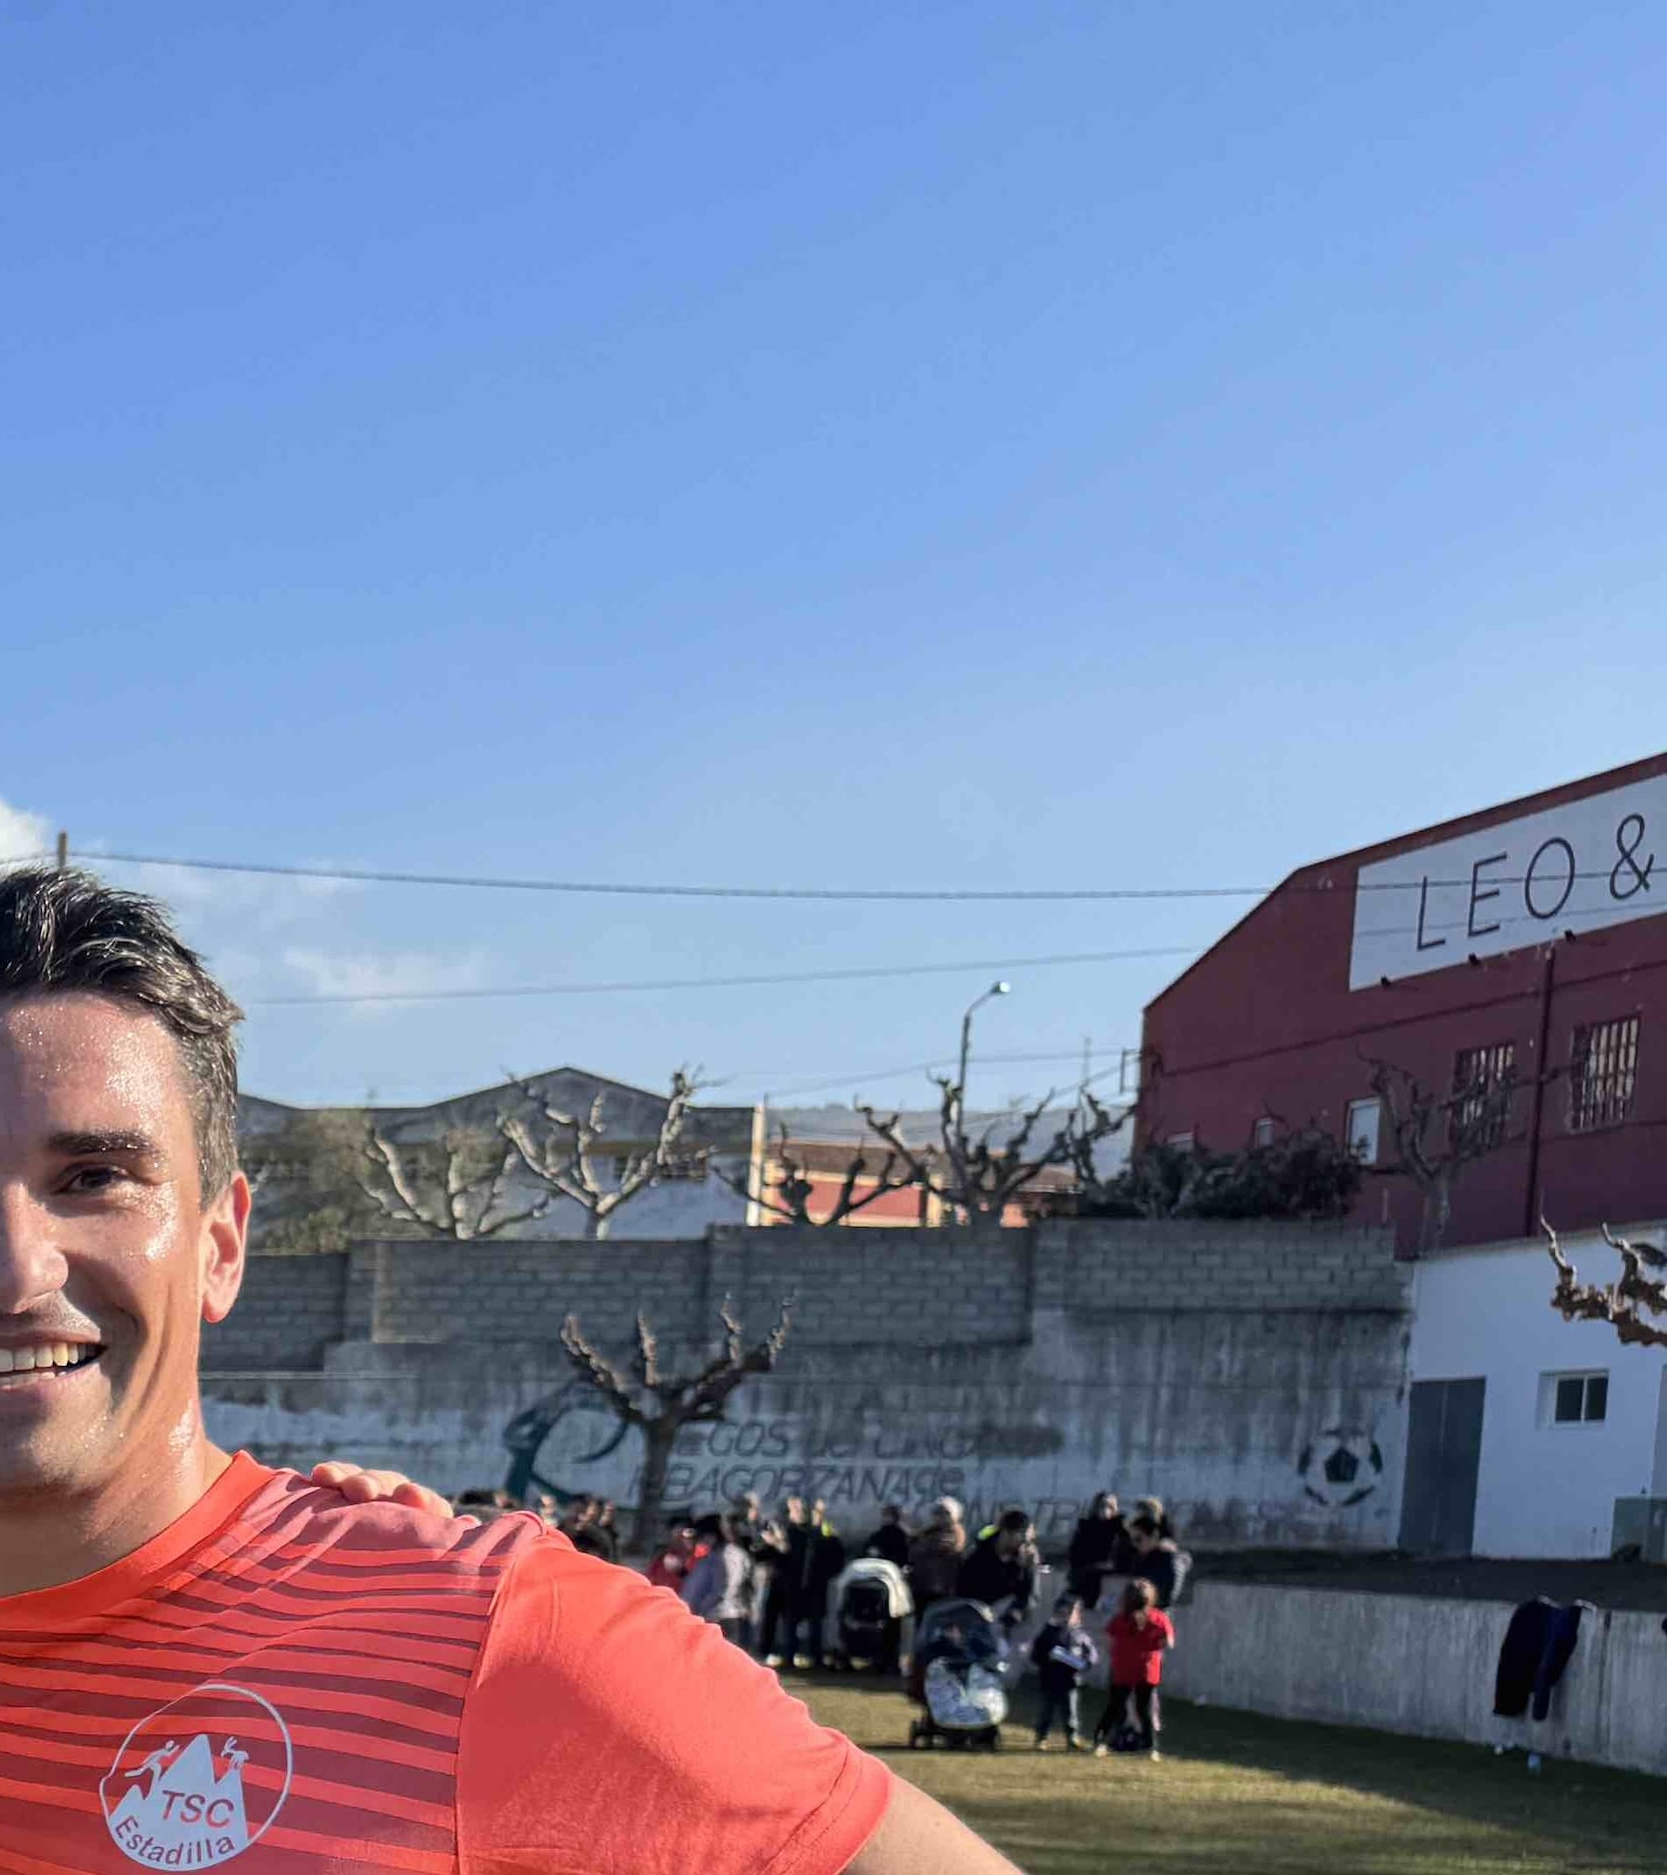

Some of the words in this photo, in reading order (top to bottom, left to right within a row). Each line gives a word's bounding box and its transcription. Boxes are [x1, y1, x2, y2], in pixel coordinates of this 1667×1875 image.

[1418, 836, 1576, 951] LEO
[1609, 813, 1655, 900] &
[162, 1789, 235, 1829] TSC
[114, 1815, 236, 1866] Estadilla
